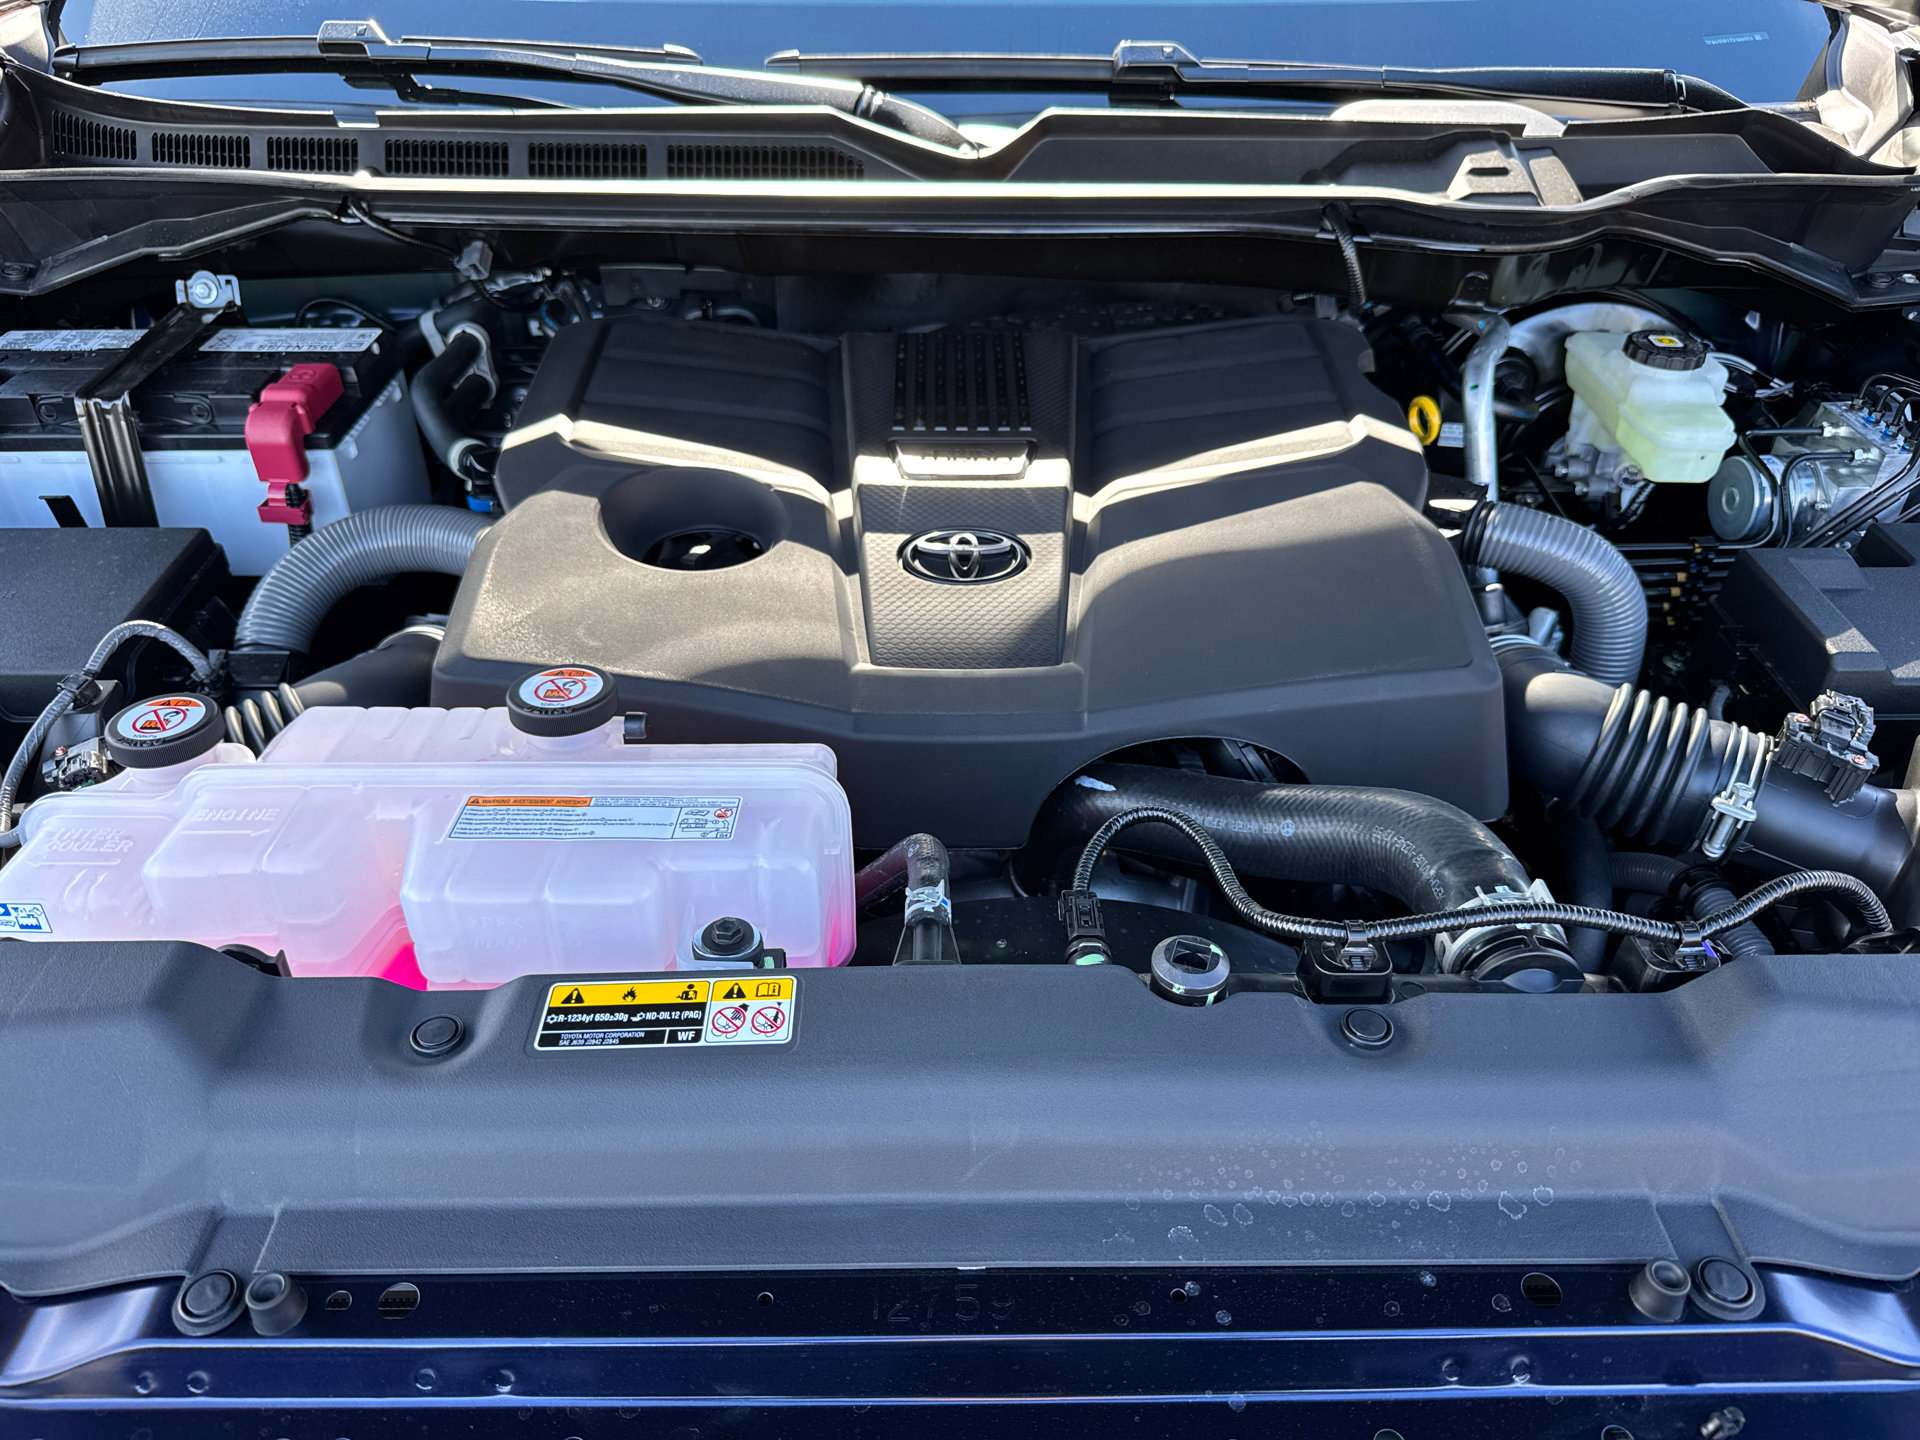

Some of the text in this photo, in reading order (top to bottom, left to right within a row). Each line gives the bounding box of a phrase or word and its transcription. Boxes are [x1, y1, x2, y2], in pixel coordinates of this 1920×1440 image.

[190, 808, 281, 822] ENGINE
[54, 827, 125, 840] INTER
[45, 839, 134, 853] COOLER
[557, 1012, 629, 1024] R-1234yf 650±30g
[645, 1010, 702, 1020] ND-OIL12 (PAG)
[677, 1031, 696, 1041] WF
